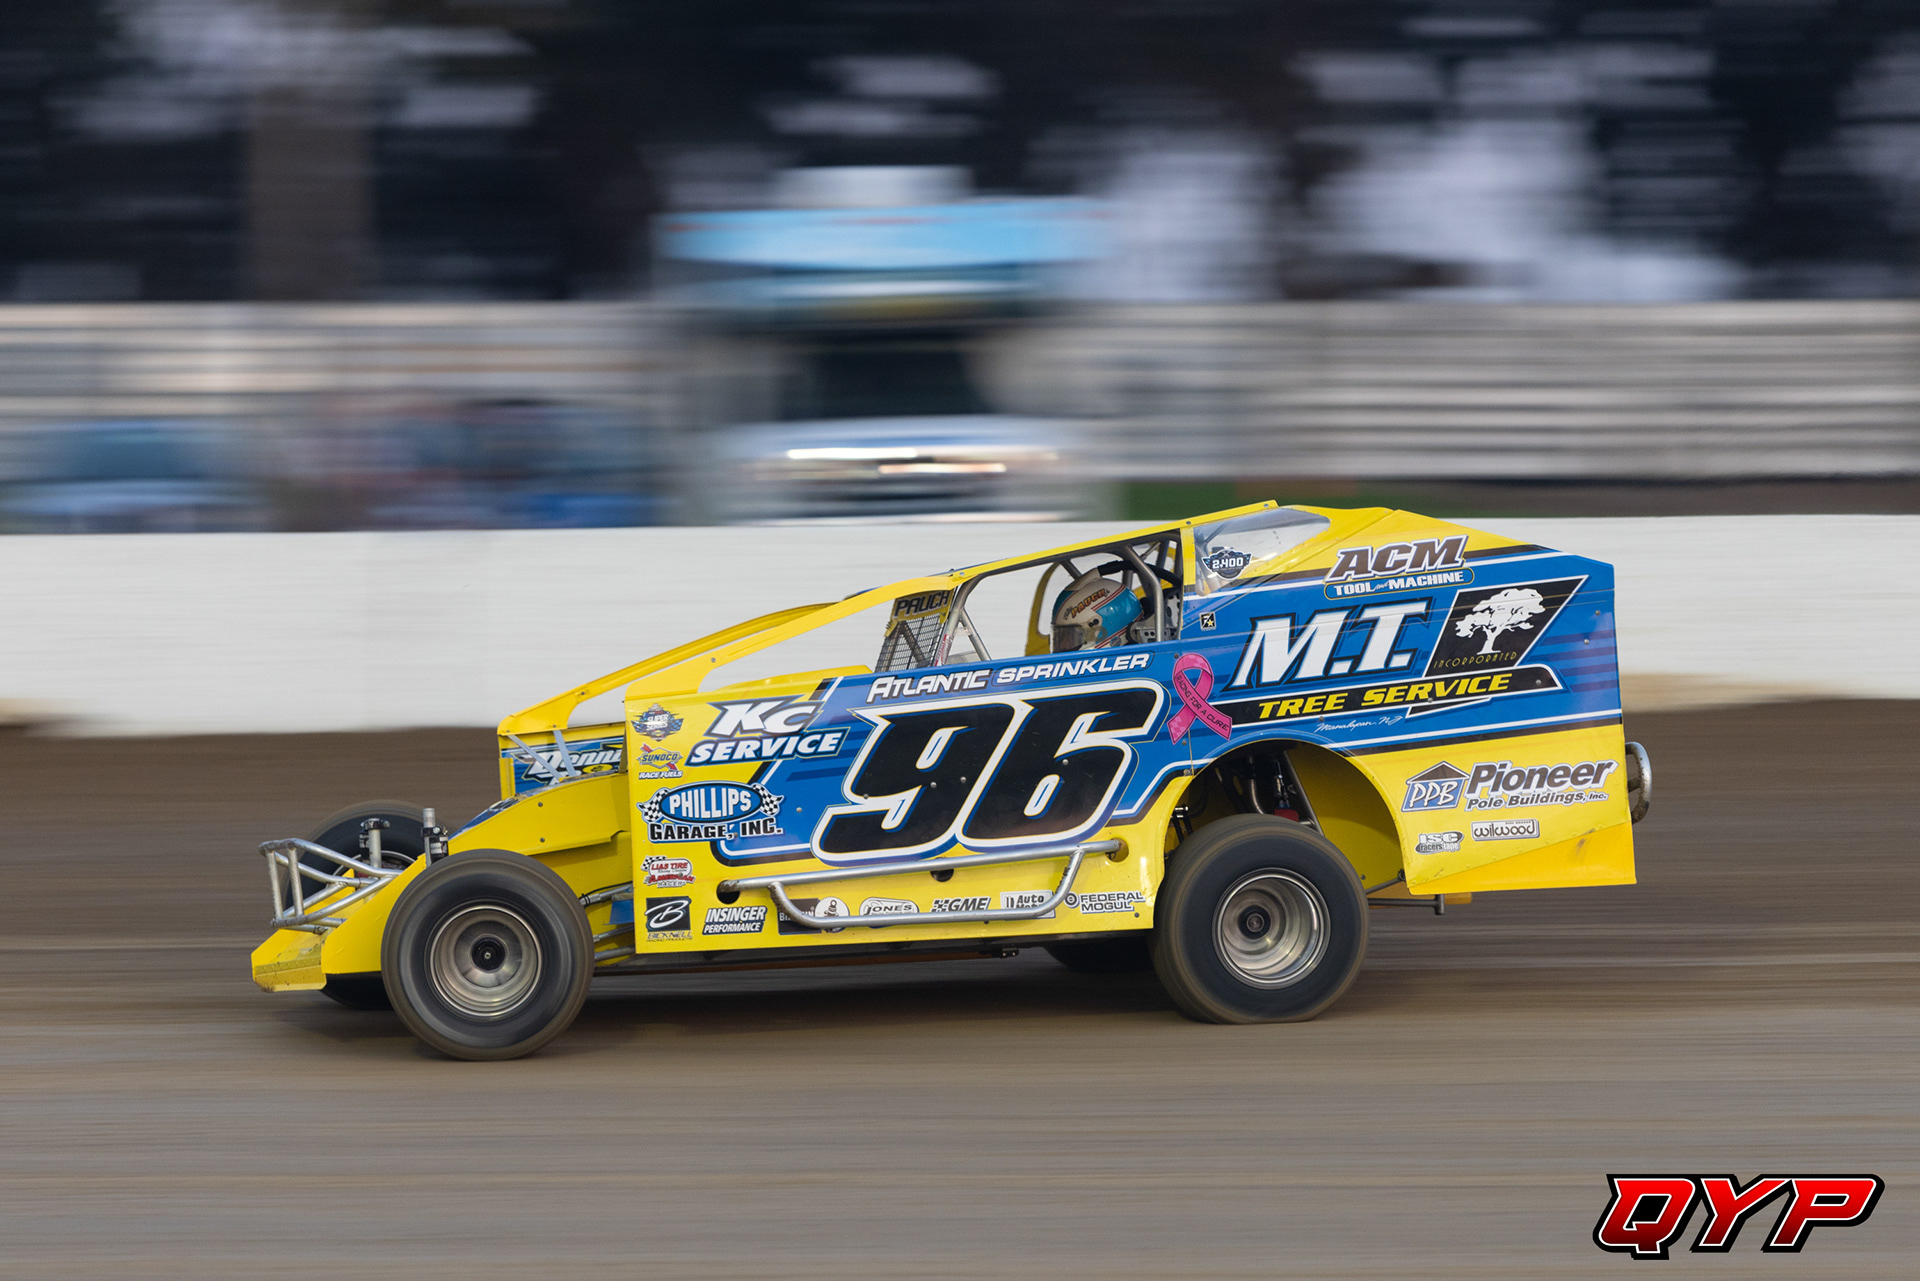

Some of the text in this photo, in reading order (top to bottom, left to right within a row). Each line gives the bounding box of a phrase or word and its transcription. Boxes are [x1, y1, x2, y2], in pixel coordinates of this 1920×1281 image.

[1326, 535, 1467, 581] ACM
[1334, 582, 1375, 596] TOOL
[1389, 572, 1464, 590] MACHINE
[893, 590, 951, 619] PAUCH
[1229, 600, 1428, 687] M.T.
[1433, 651, 1518, 669] INCORPORATED
[866, 654, 1150, 704] ATLANTIC SPRINKLER
[1176, 675, 1192, 698] RACING
[1190, 696, 1203, 711] FOR
[1206, 713, 1230, 731] CURE
[1259, 673, 1512, 719] TREE SERVICE
[641, 753, 678, 762] SUNOCO
[688, 731, 844, 764] SERVICE
[660, 770, 683, 778] FUELS
[814, 682, 1164, 862] 96
[1466, 760, 1616, 796] Pioneer
[669, 787, 752, 819] PHILLIPS
[1409, 780, 1459, 808] PPB
[1467, 791, 1608, 810] Pole Buildings, Inc.
[650, 817, 783, 840] GARAGE, INC.
[1473, 819, 1536, 838] wilwood
[1421, 842, 1459, 851] racers tape
[950, 898, 988, 912] GME
[1017, 894, 1044, 904] Auto
[1080, 892, 1144, 902] FEDERAL
[1081, 901, 1133, 911] MOGUL
[705, 906, 767, 922] INSINGER
[863, 905, 913, 915] JONES
[703, 922, 761, 934] PERFORMANCE
